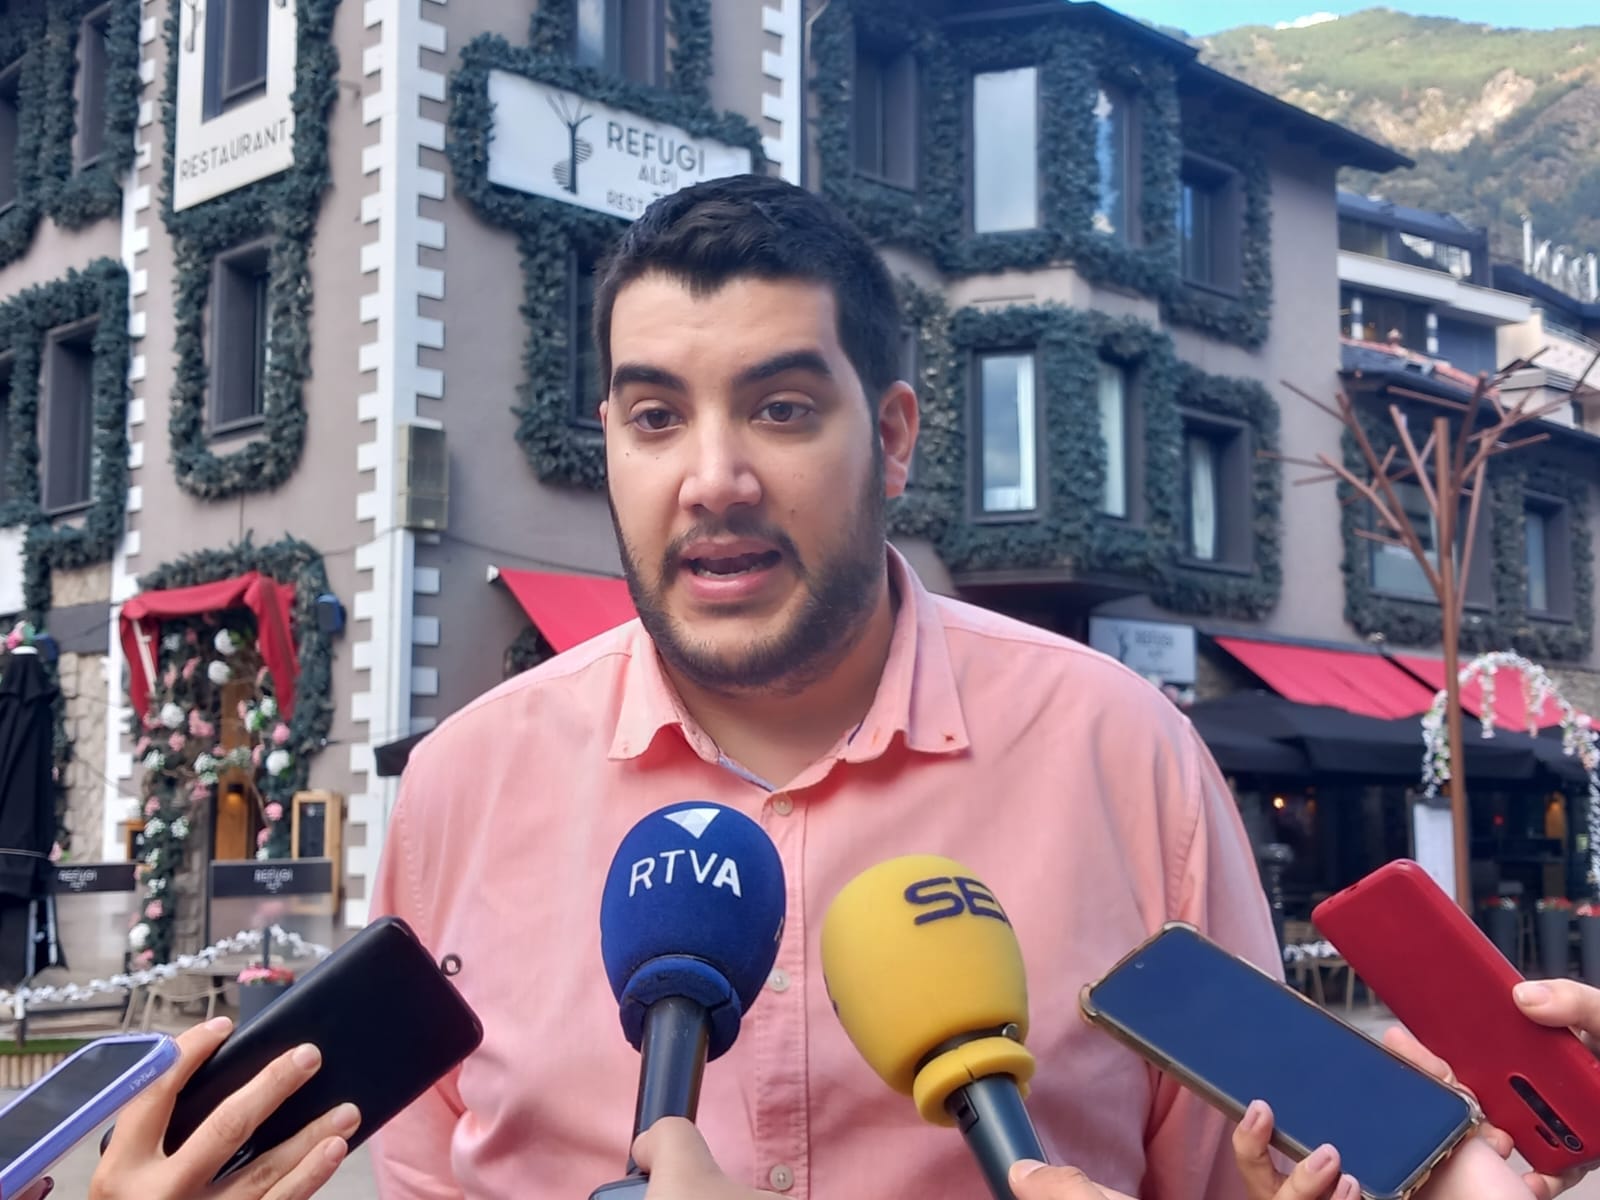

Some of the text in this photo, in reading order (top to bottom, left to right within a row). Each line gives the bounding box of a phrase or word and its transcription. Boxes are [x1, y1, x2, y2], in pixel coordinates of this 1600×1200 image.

[180, 117, 288, 180] RESTAURANT
[607, 121, 705, 175] REFUGI
[606, 191, 645, 215] REST
[629, 849, 742, 898] RTVA
[904, 876, 1012, 927] SE
